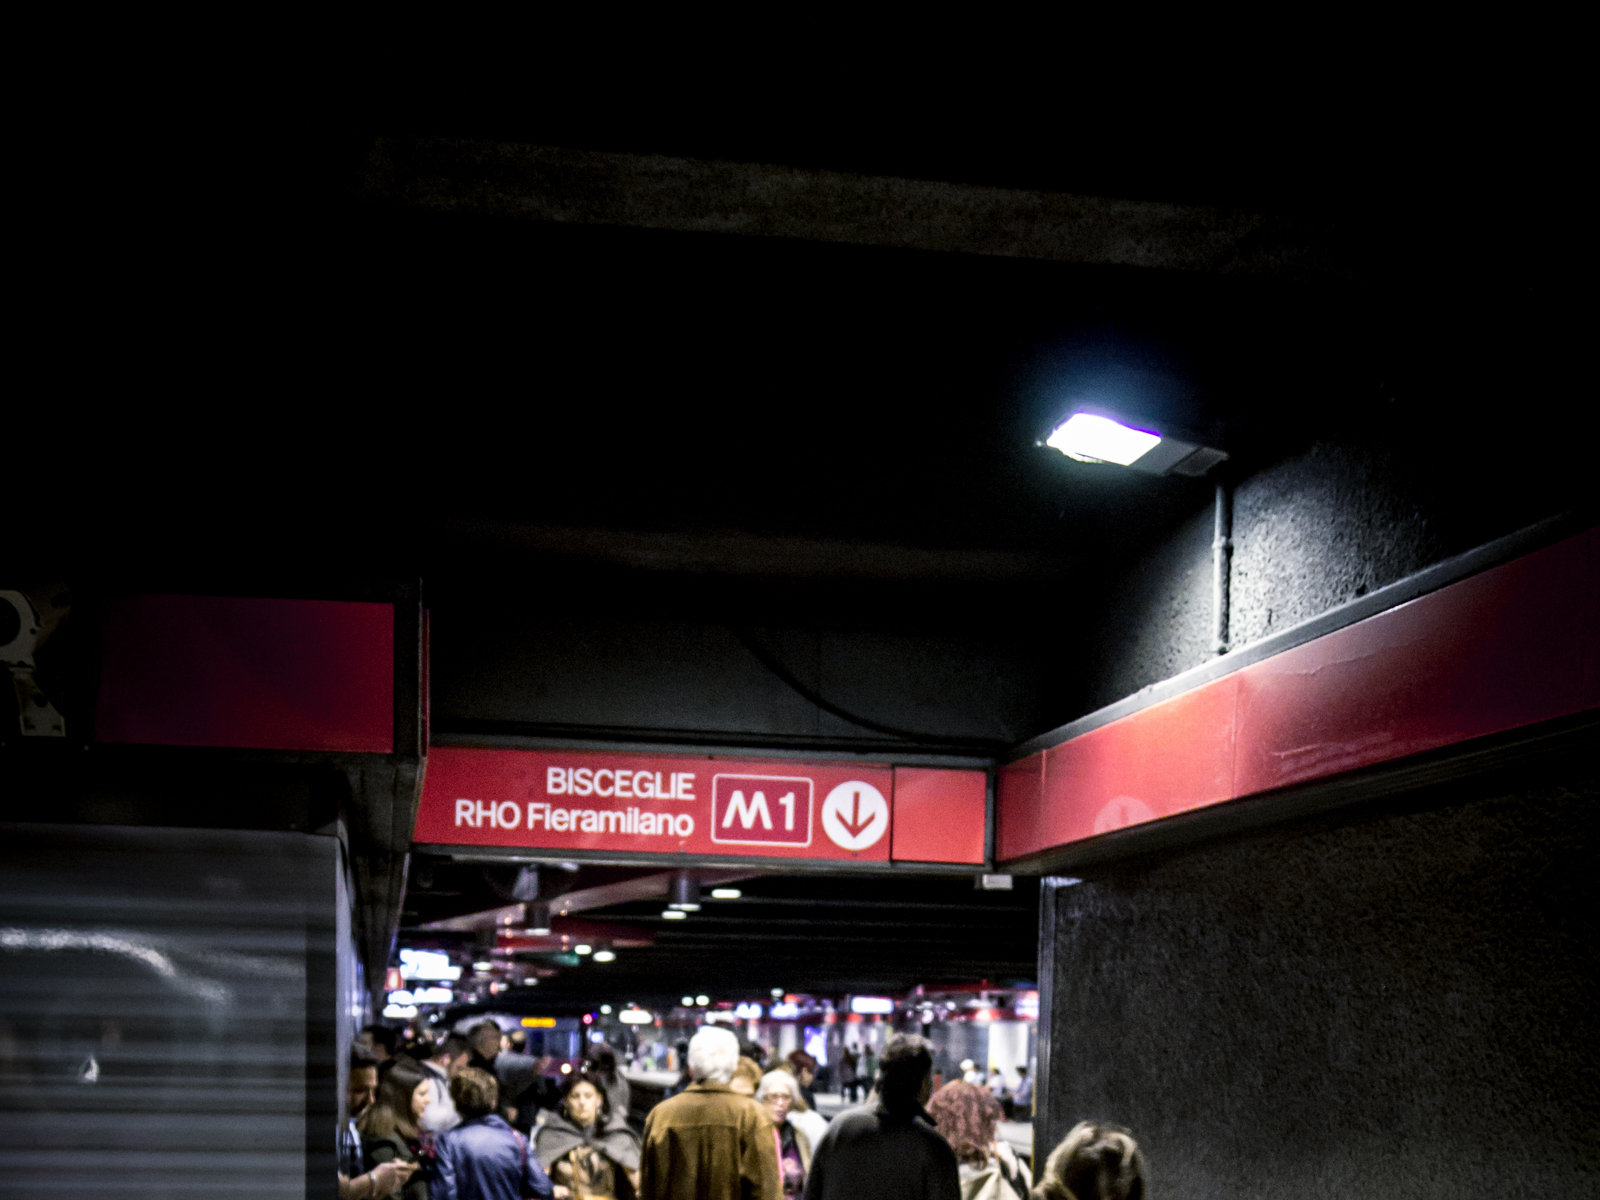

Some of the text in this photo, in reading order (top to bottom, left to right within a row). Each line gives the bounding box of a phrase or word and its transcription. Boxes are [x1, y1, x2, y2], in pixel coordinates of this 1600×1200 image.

[546, 766, 696, 801] BISCEGLIE
[455, 799, 696, 838] RHO Fieramilano
